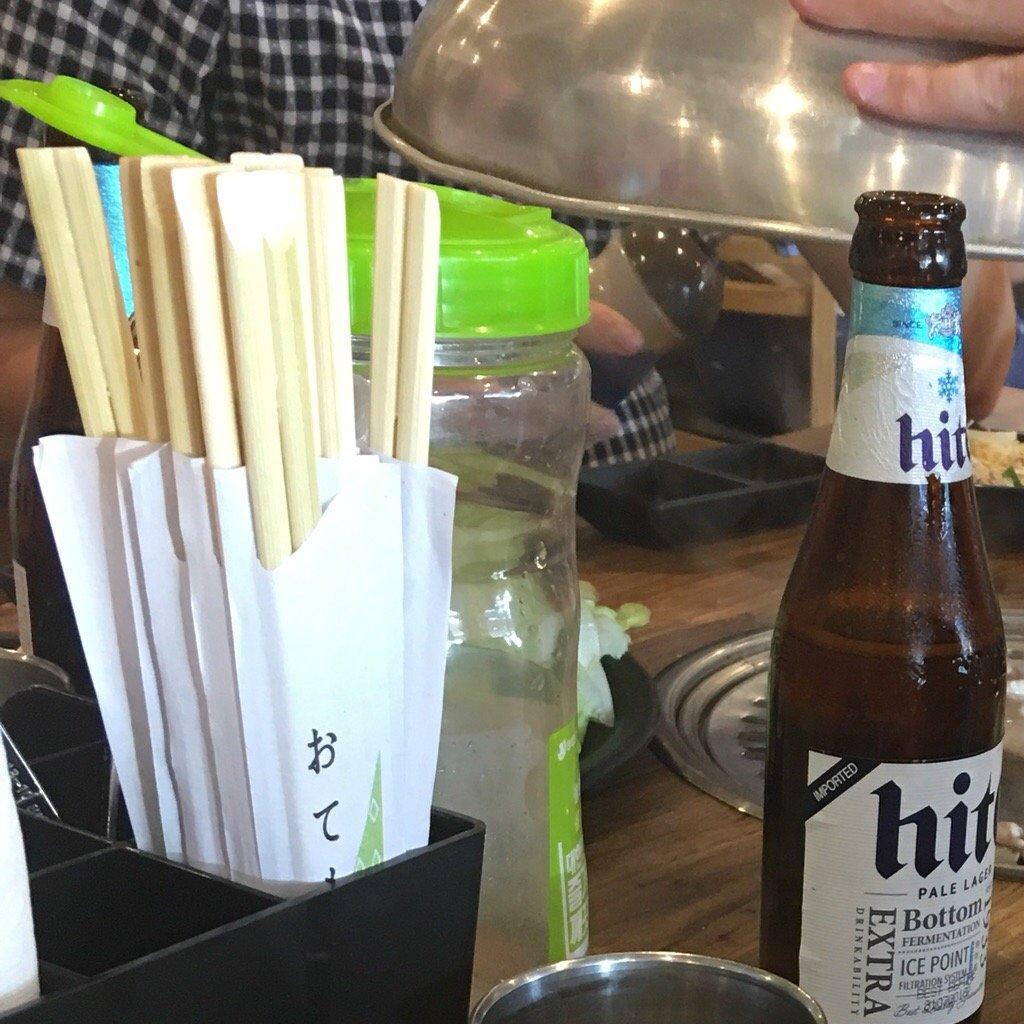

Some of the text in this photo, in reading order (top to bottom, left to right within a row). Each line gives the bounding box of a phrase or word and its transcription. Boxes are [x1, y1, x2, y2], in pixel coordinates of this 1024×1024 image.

[896, 409, 971, 474] hit
[813, 762, 858, 803] IMPORTED
[870, 772, 1000, 880] hit
[918, 882, 957, 900] PALE
[901, 919, 981, 947] FERMENTATION
[902, 897, 982, 932] Bottom
[849, 906, 866, 1016] DRINKABILITY
[864, 906, 897, 1017] EXTRA
[900, 946, 969, 977] ICE POINT
[898, 976, 943, 991] FILTRATION
